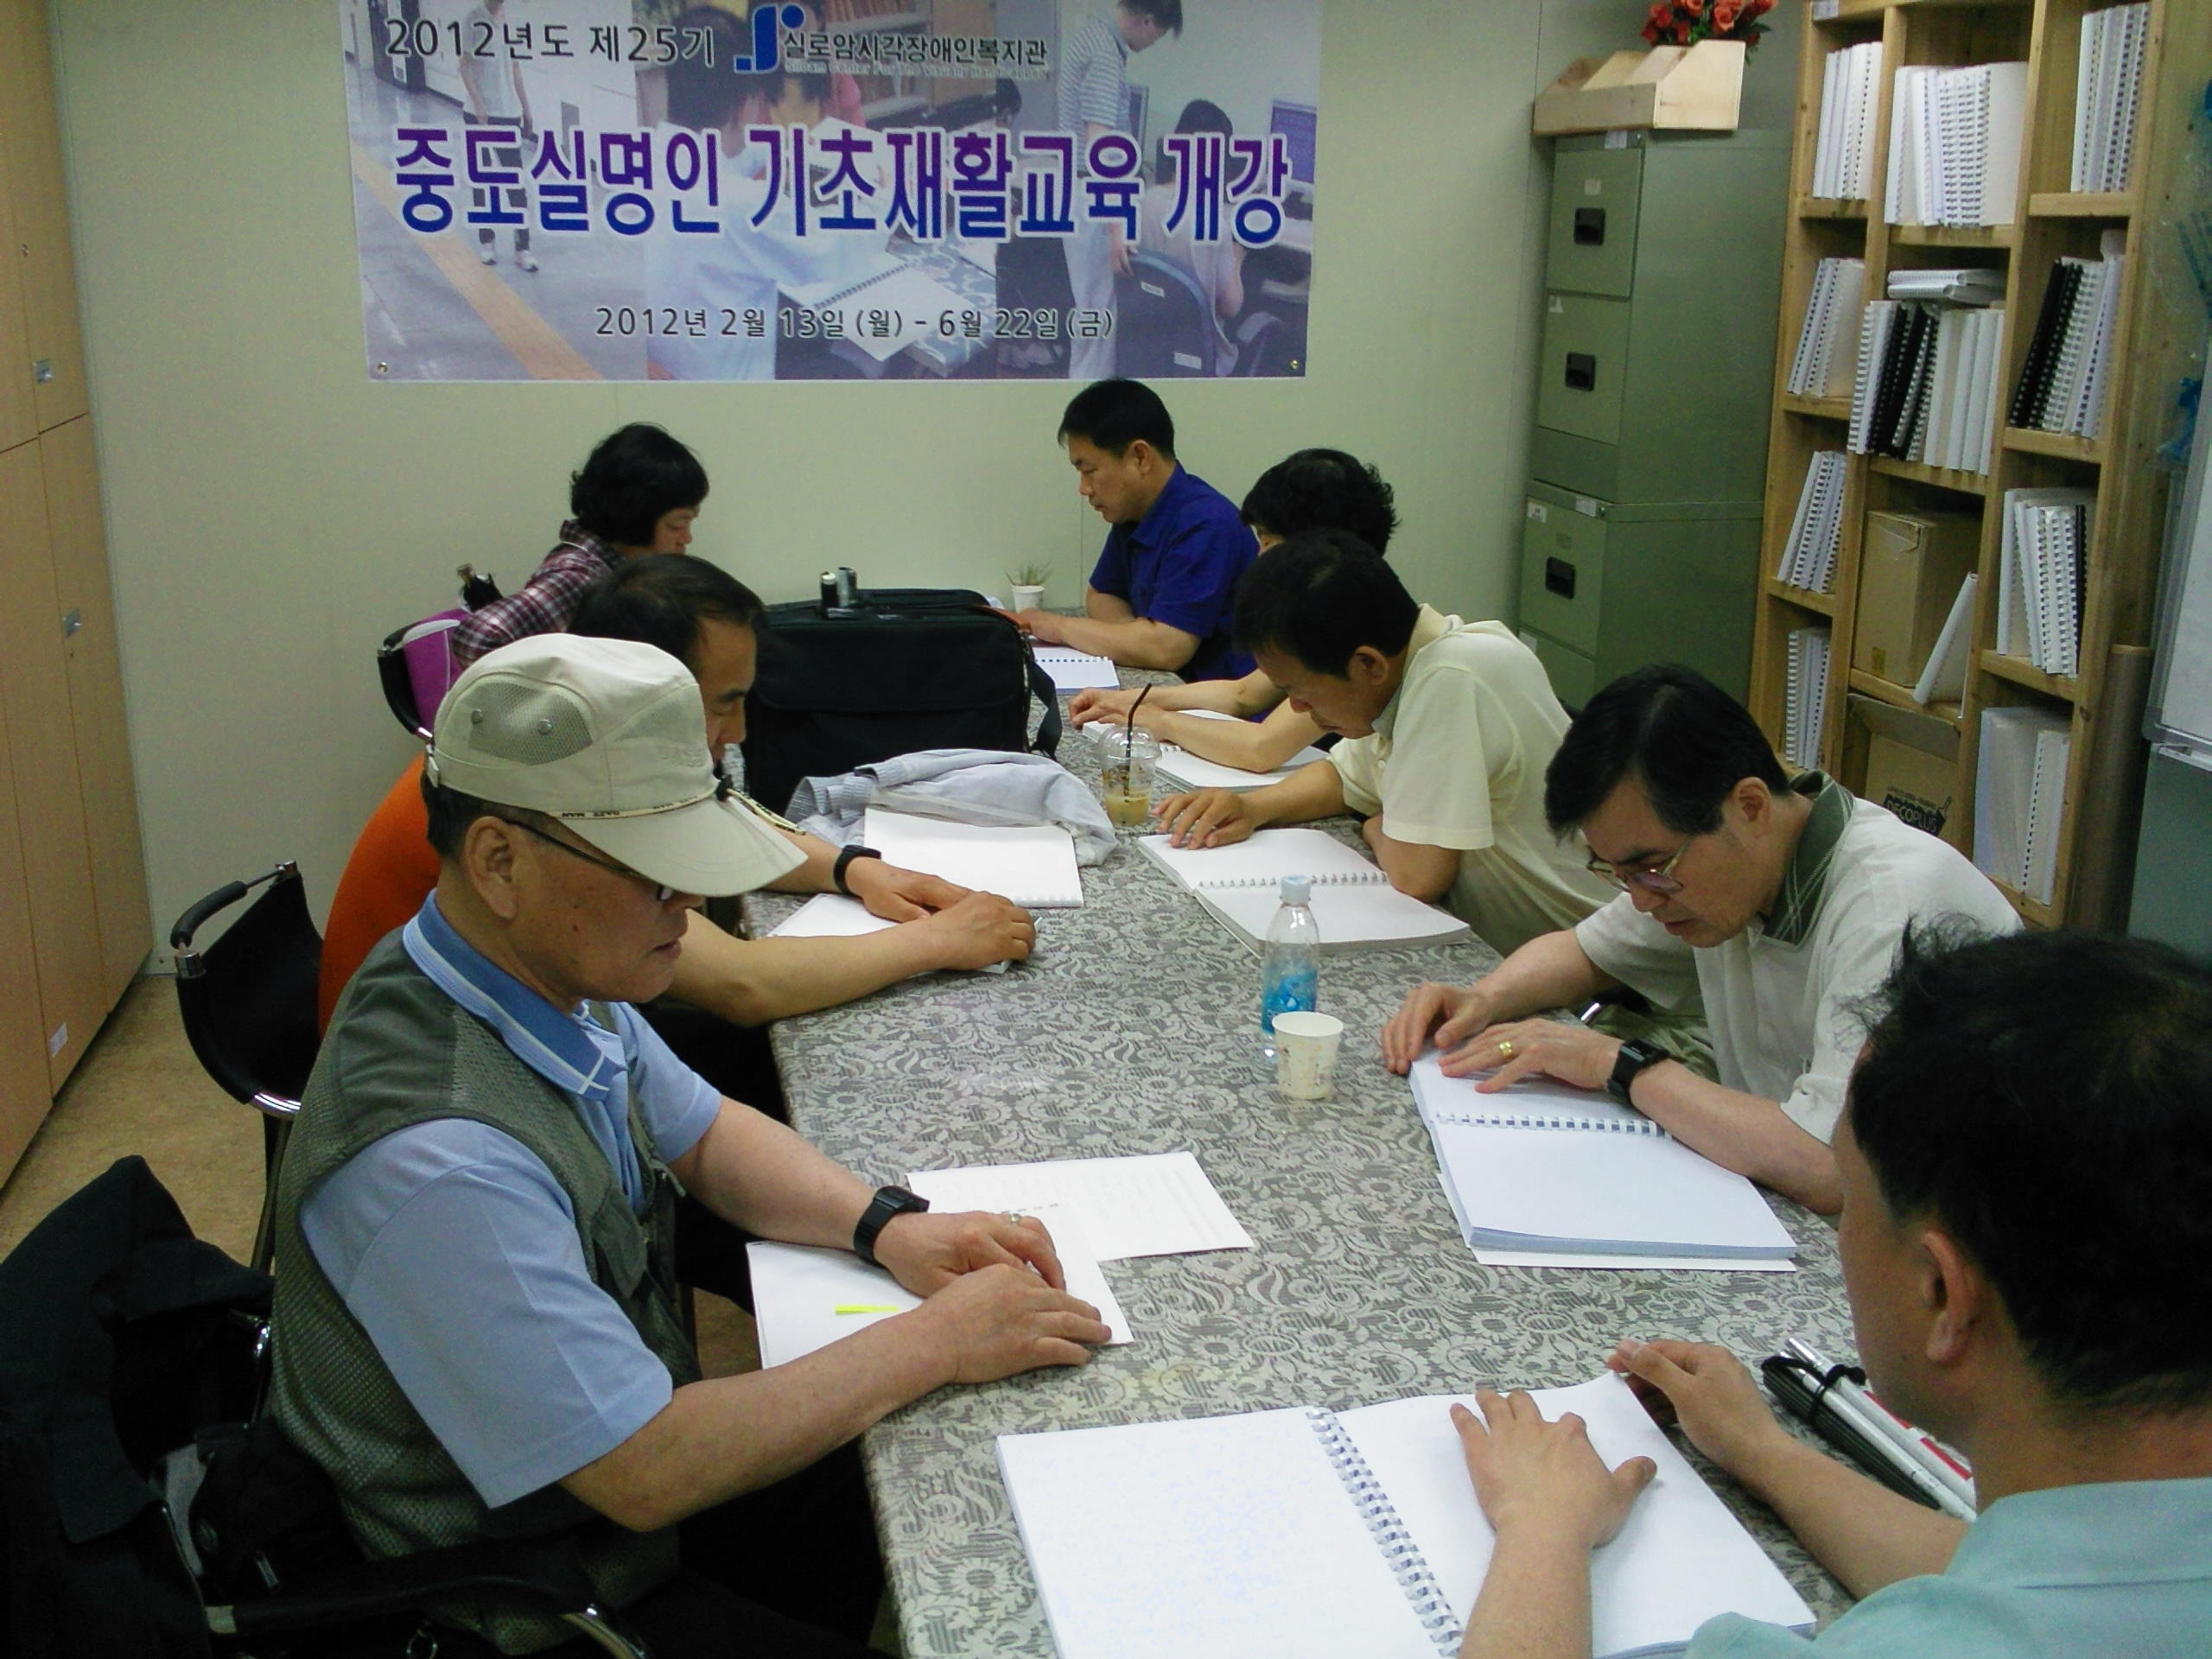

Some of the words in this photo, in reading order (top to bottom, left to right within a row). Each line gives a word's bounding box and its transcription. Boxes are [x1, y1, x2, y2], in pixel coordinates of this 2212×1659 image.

[385, 19, 575, 60] 2012년도
[588, 25, 715, 68] 제25기
[784, 32, 1047, 67] 실로암시각장애인복지관
[395, 127, 721, 237] 중도실명인
[749, 126, 1141, 241] 기초재활교육
[1165, 135, 1288, 245] 개강
[596, 307, 707, 337] 2012년
[720, 308, 766, 338] 2월
[938, 308, 982, 338] 6월
